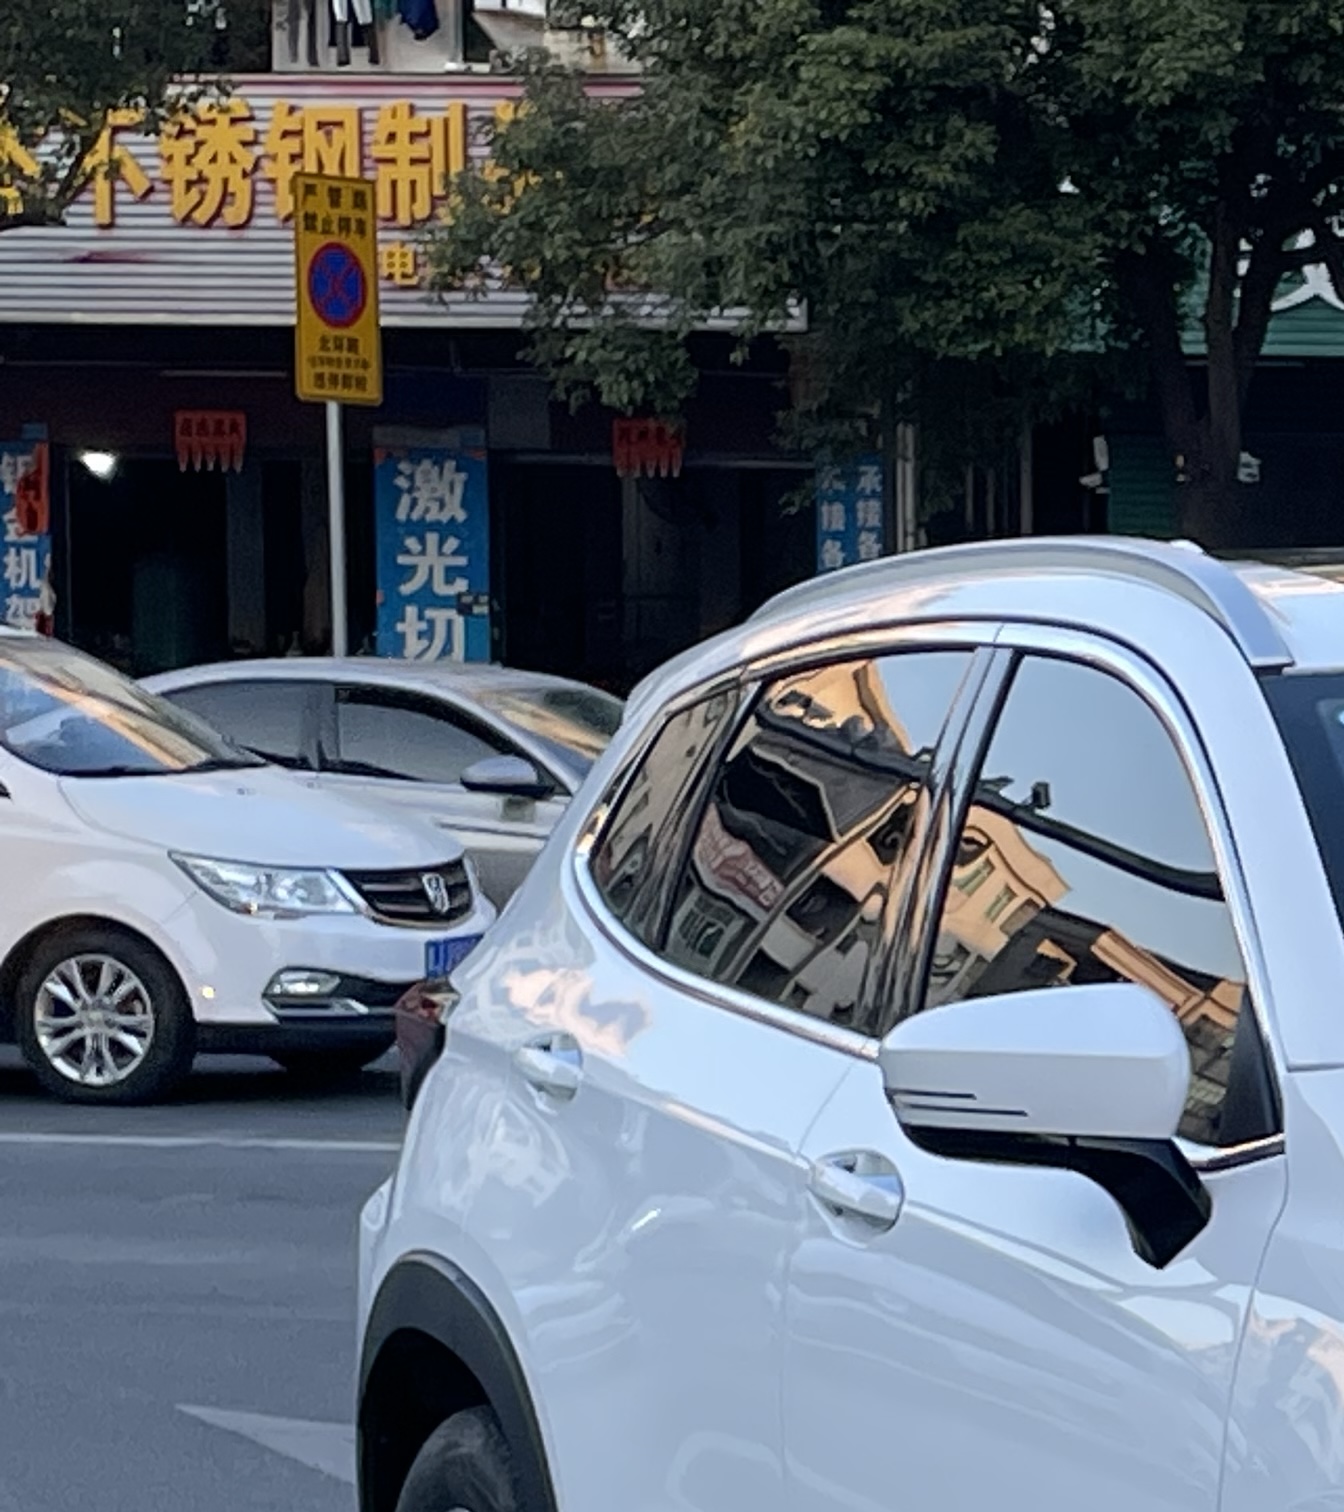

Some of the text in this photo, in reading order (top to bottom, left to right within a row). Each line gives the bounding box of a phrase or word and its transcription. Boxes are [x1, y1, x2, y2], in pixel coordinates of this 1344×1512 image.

[0, 98, 540, 228] 不锈钢制
[393, 458, 469, 663] 激光切
